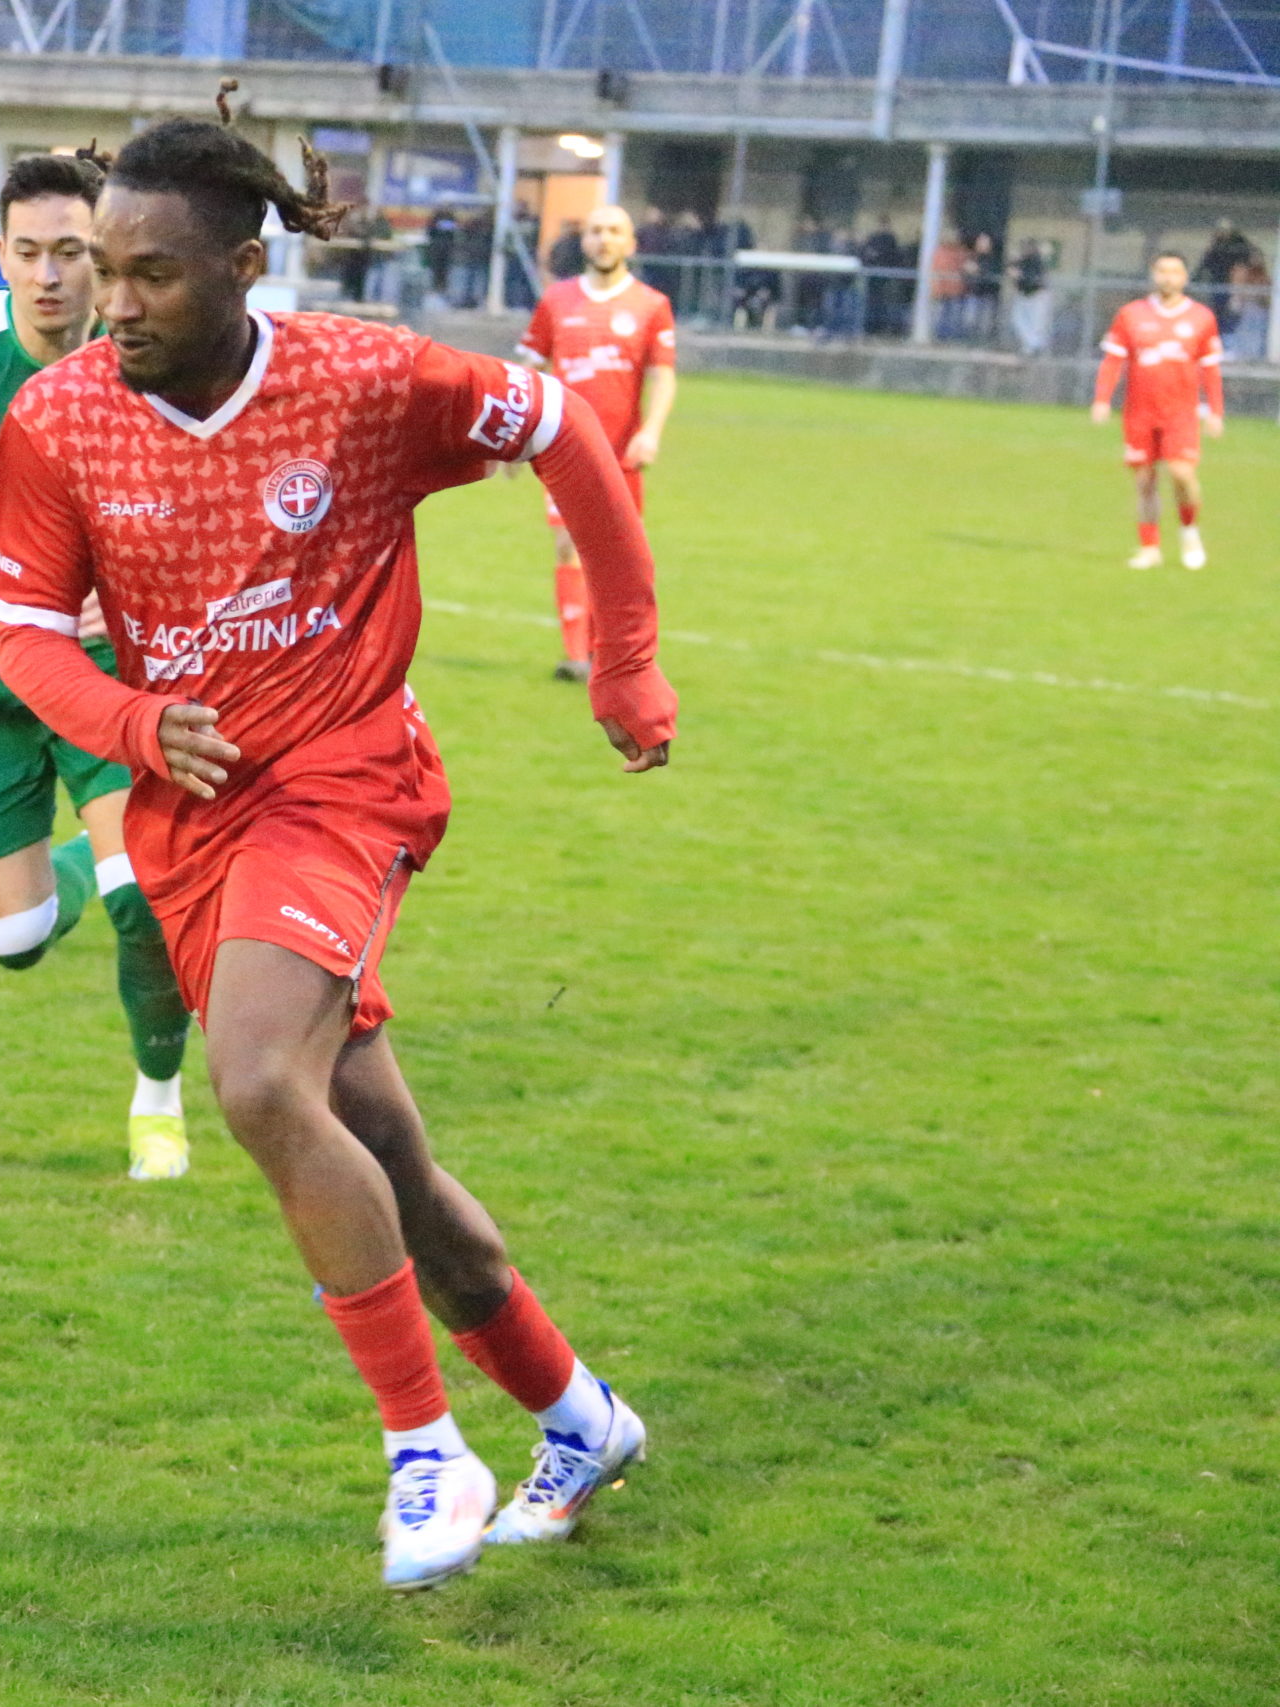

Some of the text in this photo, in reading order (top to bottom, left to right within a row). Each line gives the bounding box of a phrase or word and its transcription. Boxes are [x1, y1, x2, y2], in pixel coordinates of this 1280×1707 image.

[495, 362, 533, 442] MCM
[99, 502, 157, 517] CRAFT
[291, 518, 314, 532] 1923
[121, 602, 342, 657] DE AGOSTINI SA
[280, 904, 340, 942] CRAFT
